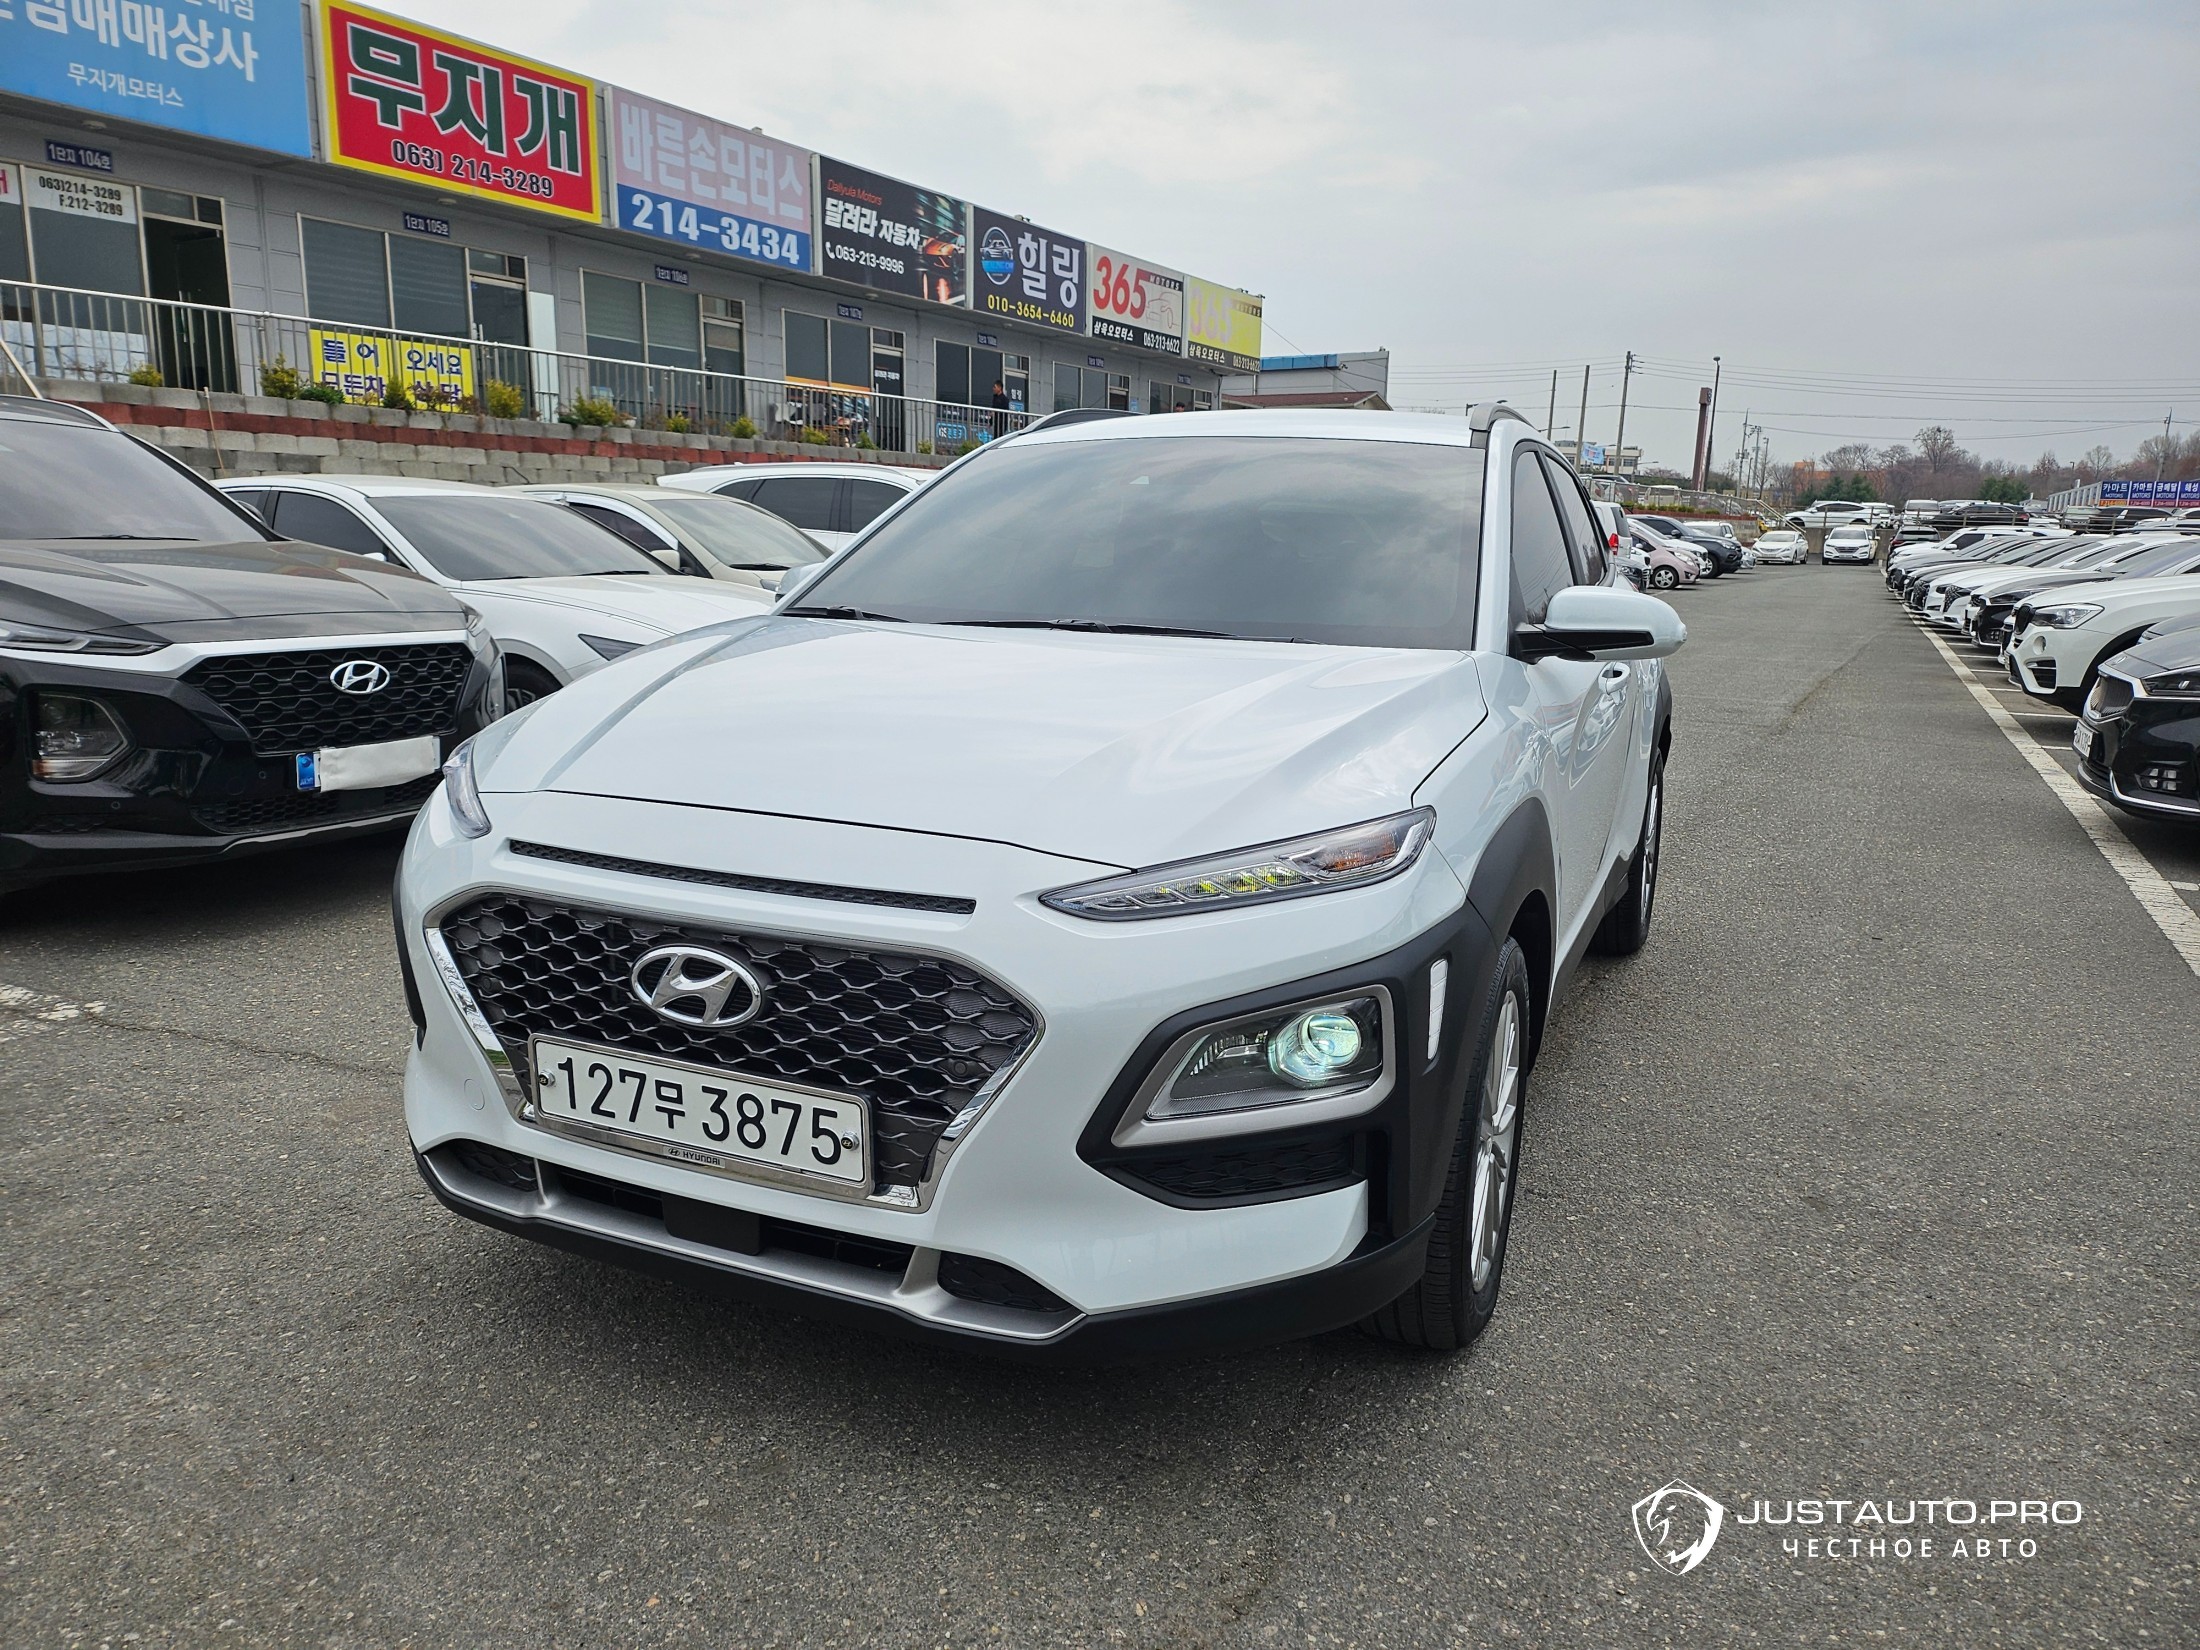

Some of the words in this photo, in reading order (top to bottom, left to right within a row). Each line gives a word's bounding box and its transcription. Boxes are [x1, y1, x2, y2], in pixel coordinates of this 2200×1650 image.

[67, 62, 184, 107] 무지개모터스
[346, 21, 582, 176] 무지개
[78, 149, 111, 170] 104호
[391, 139, 444, 172] 063)
[451, 154, 554, 197] 214-3289
[620, 102, 804, 220] 바른손모터스
[39, 175, 122, 201] 063)214-3289
[857, 189, 883, 206] Motors
[632, 193, 799, 264] 214-3434
[824, 197, 878, 238] 달려라
[878, 219, 921, 250] 자동차
[835, 244, 905, 275] 063-213-9996
[1017, 231, 1081, 309] 힐링
[1093, 256, 1147, 320] 365
[1149, 274, 1180, 291] MOTORS
[987, 294, 1074, 328] 010-3654-6460
[1191, 286, 1234, 345] 365
[1093, 321, 1134, 341] 삼육오모터스
[1143, 332, 1180, 354] 063-213-6622
[1188, 343, 1225, 364] 삼육오모터스
[682, 1150, 722, 1166] HYUNDAI
